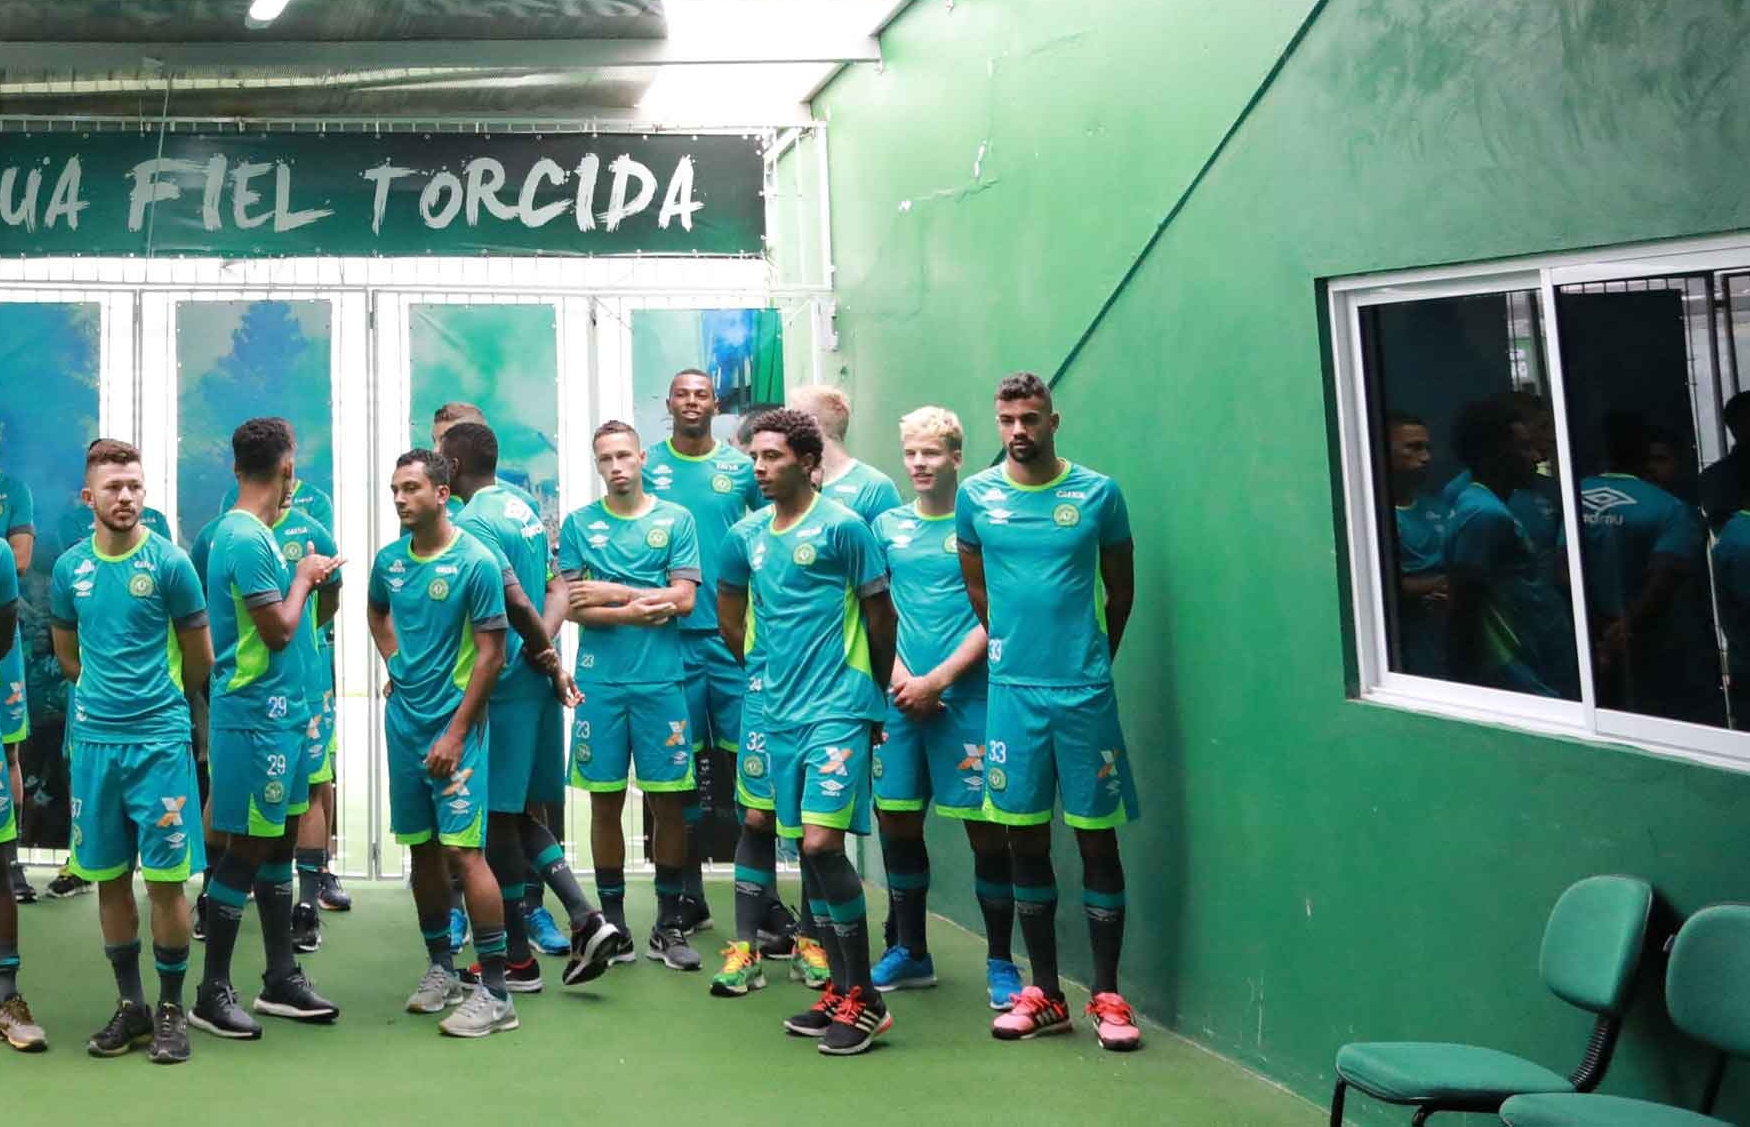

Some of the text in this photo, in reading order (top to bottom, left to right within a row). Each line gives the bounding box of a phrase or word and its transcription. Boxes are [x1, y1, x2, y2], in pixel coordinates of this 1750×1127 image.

[125, 152, 336, 233] FIEL
[360, 152, 705, 236] TORCIDA
[267, 696, 287, 719] 29
[746, 731, 767, 754] 32
[989, 739, 1007, 764] 33
[266, 754, 287, 776] 29
